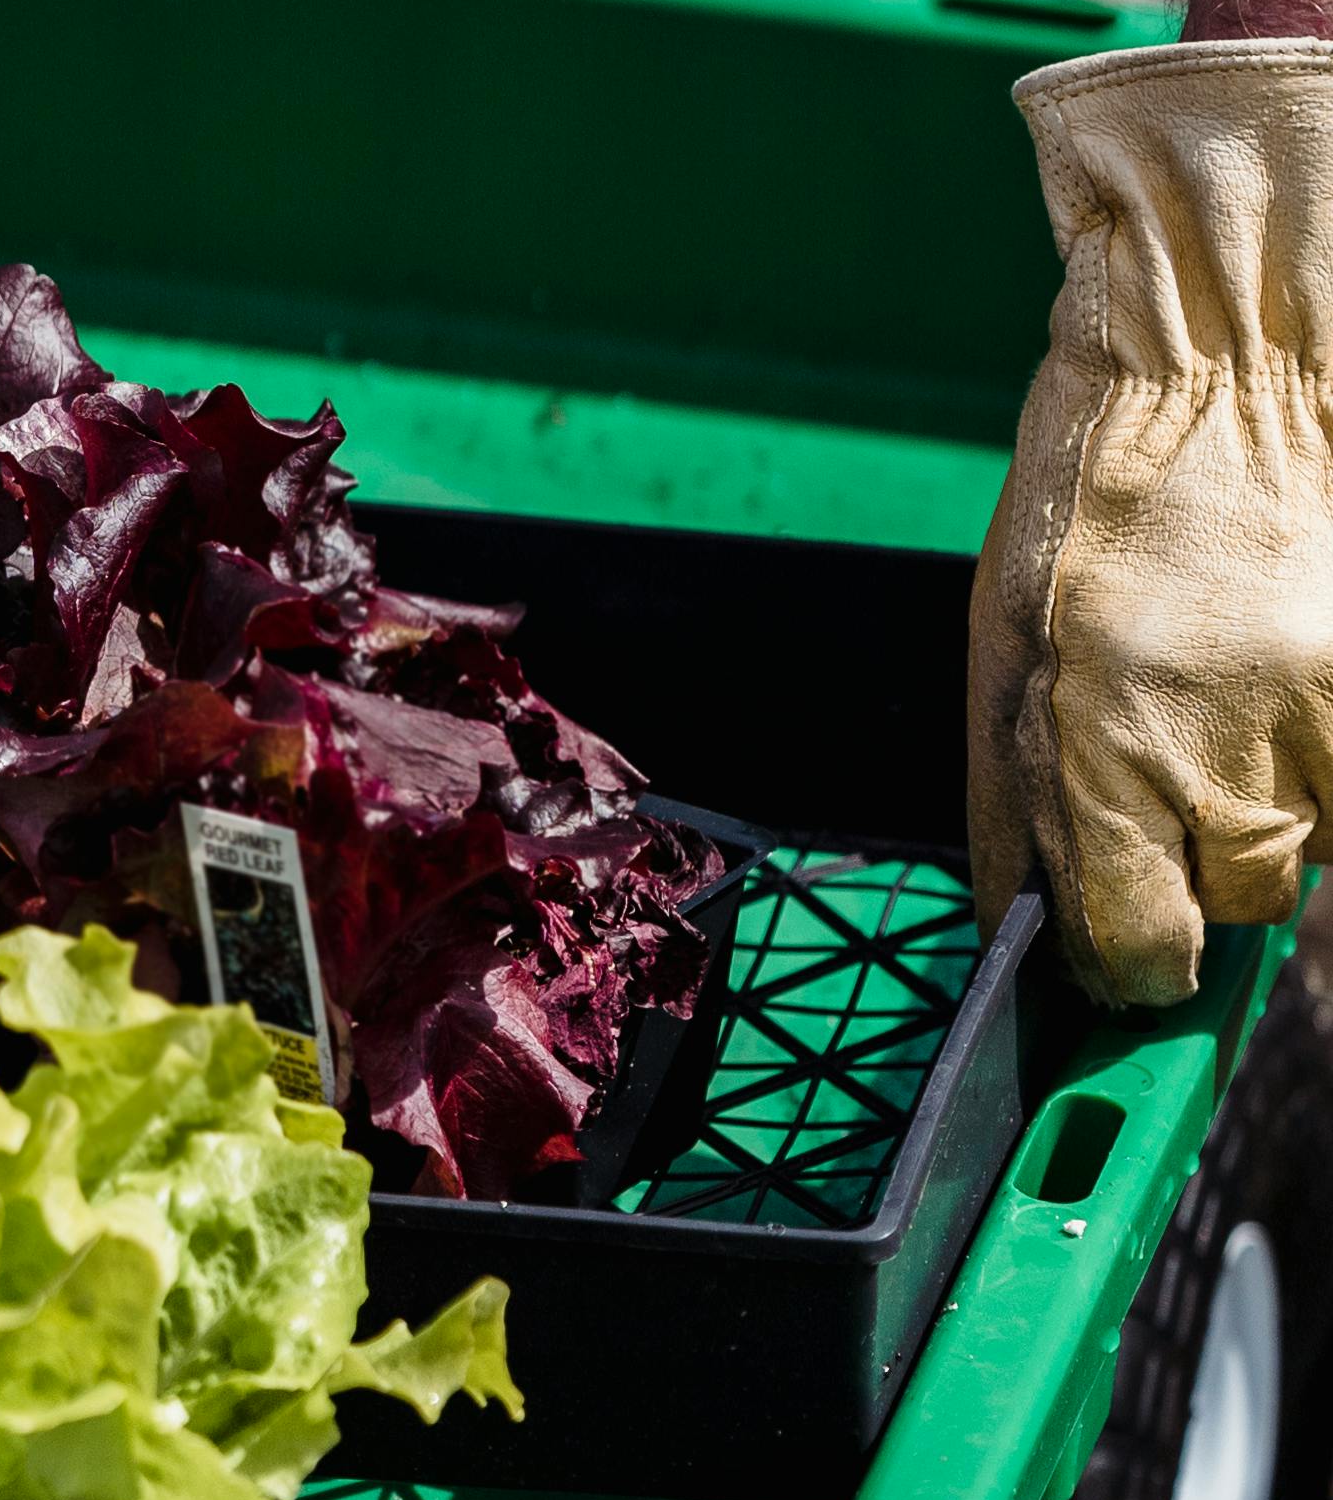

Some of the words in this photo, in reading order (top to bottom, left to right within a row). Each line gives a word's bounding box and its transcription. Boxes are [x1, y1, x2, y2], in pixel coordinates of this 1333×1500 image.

[199, 822, 282, 856] GOURMET
[204, 842, 240, 866] RED
[242, 851, 285, 876] LEAF
